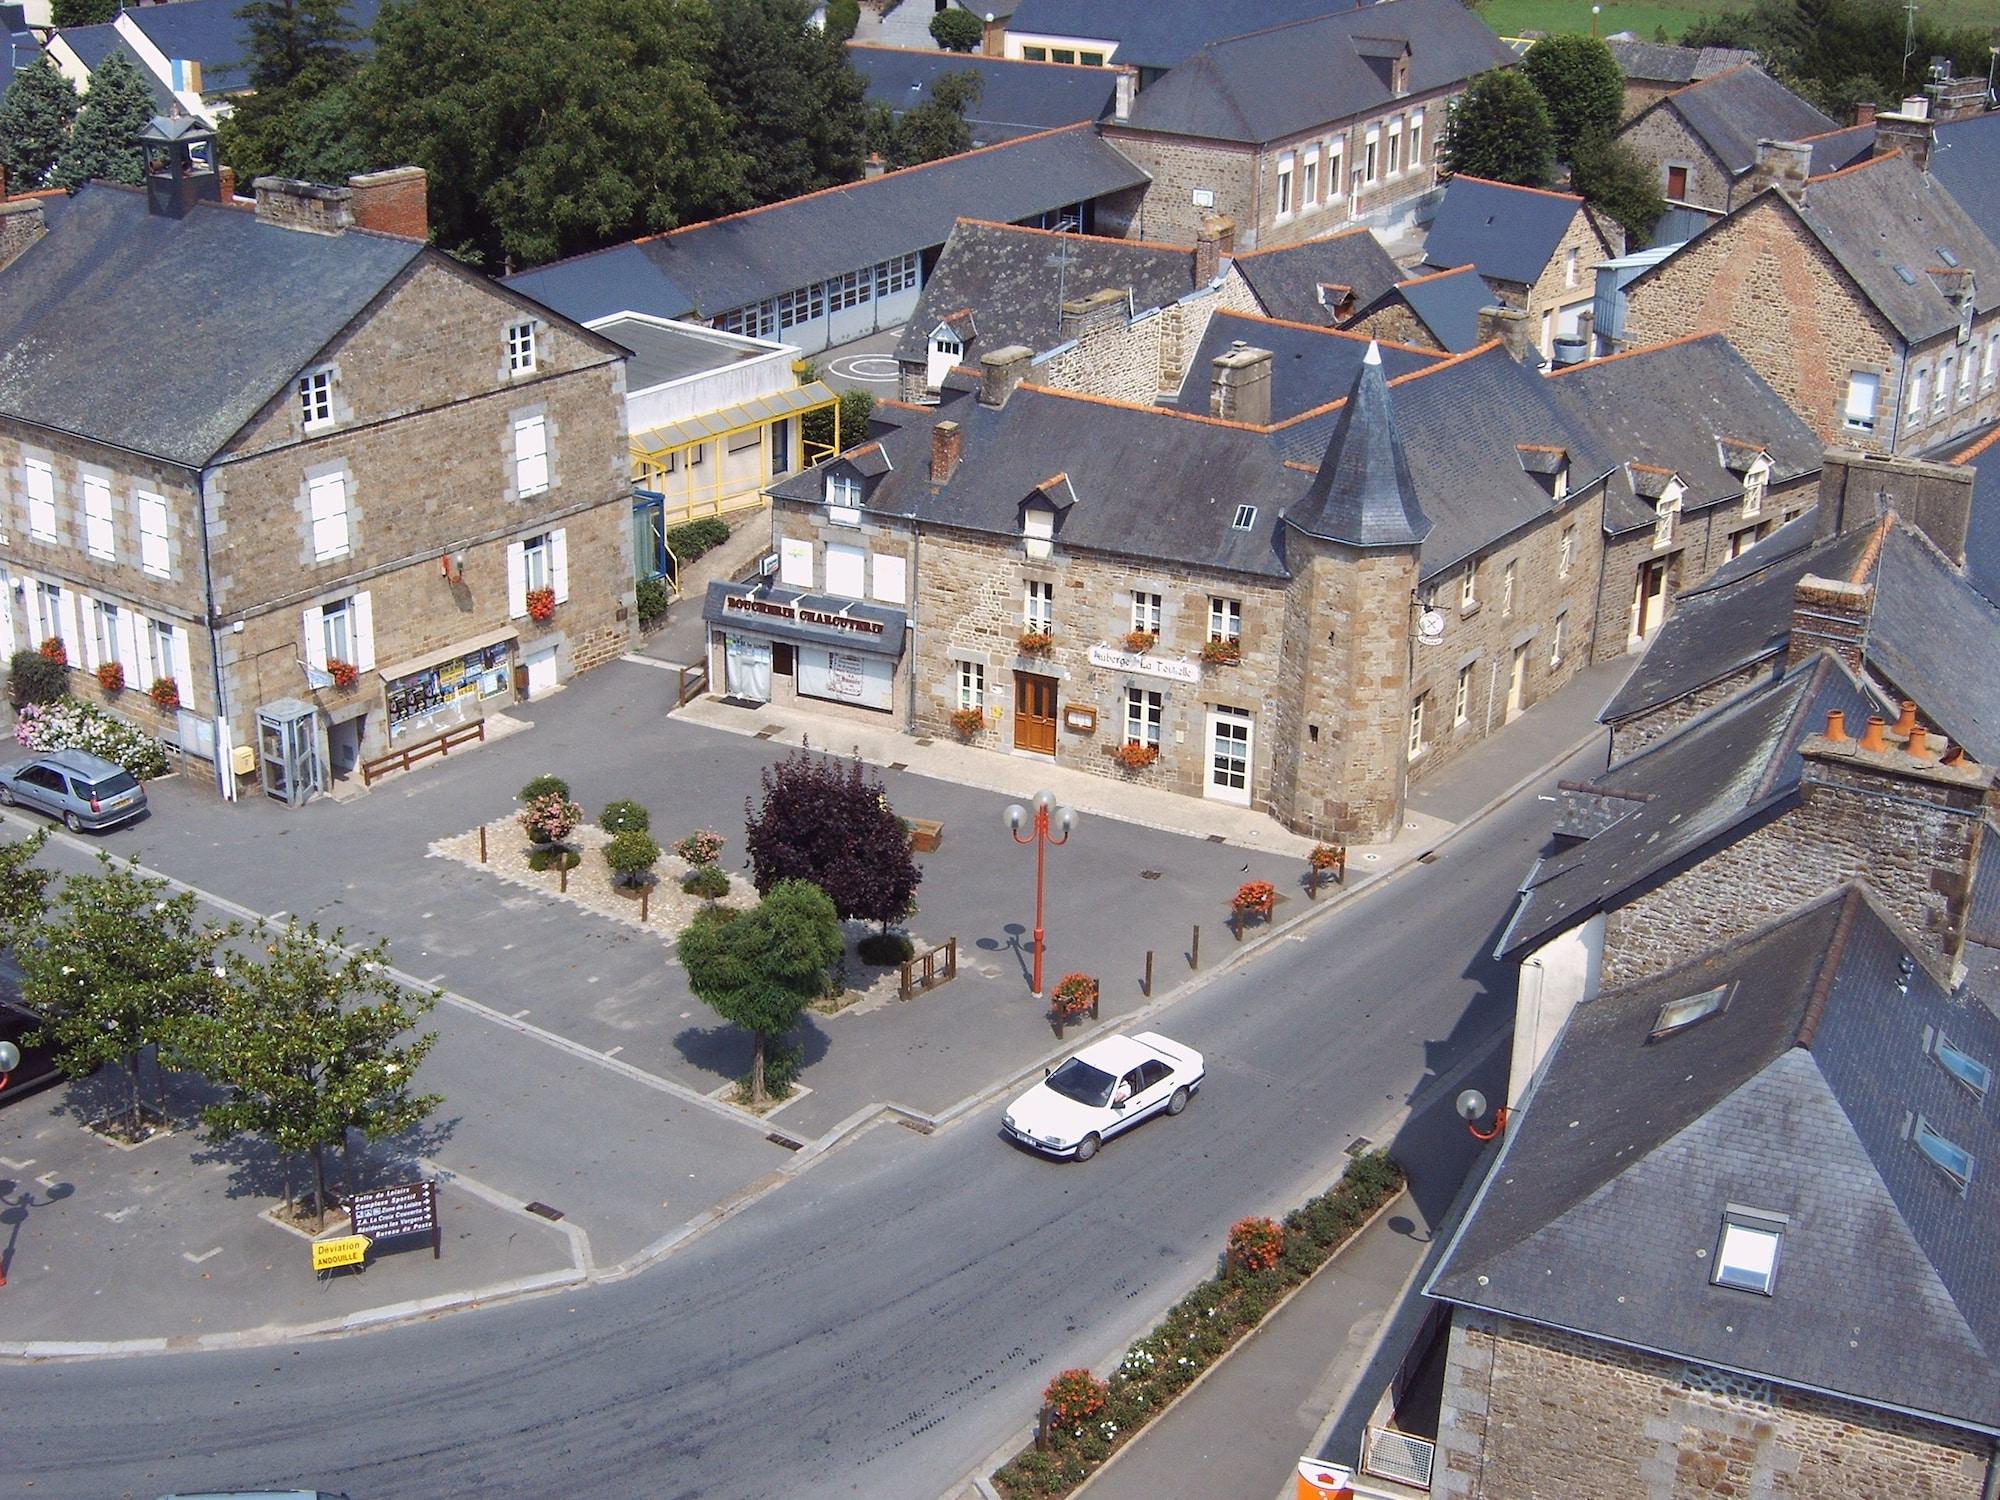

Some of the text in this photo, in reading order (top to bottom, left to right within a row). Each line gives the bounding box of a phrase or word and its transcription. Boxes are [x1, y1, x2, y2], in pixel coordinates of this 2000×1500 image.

[727, 597, 885, 633] BOUCHERIE CHARCUTERIE
[1093, 650, 1130, 668] Auberge
[1140, 658, 1152, 670] La
[355, 1195, 373, 1203] Salle
[387, 1188, 410, 1196] Loisirs
[355, 1194, 417, 1210] Complexe Sportif
[404, 1201, 422, 1209] Loisirs
[378, 1214, 394, 1222] Croix
[375, 1229, 400, 1237] Bureau
